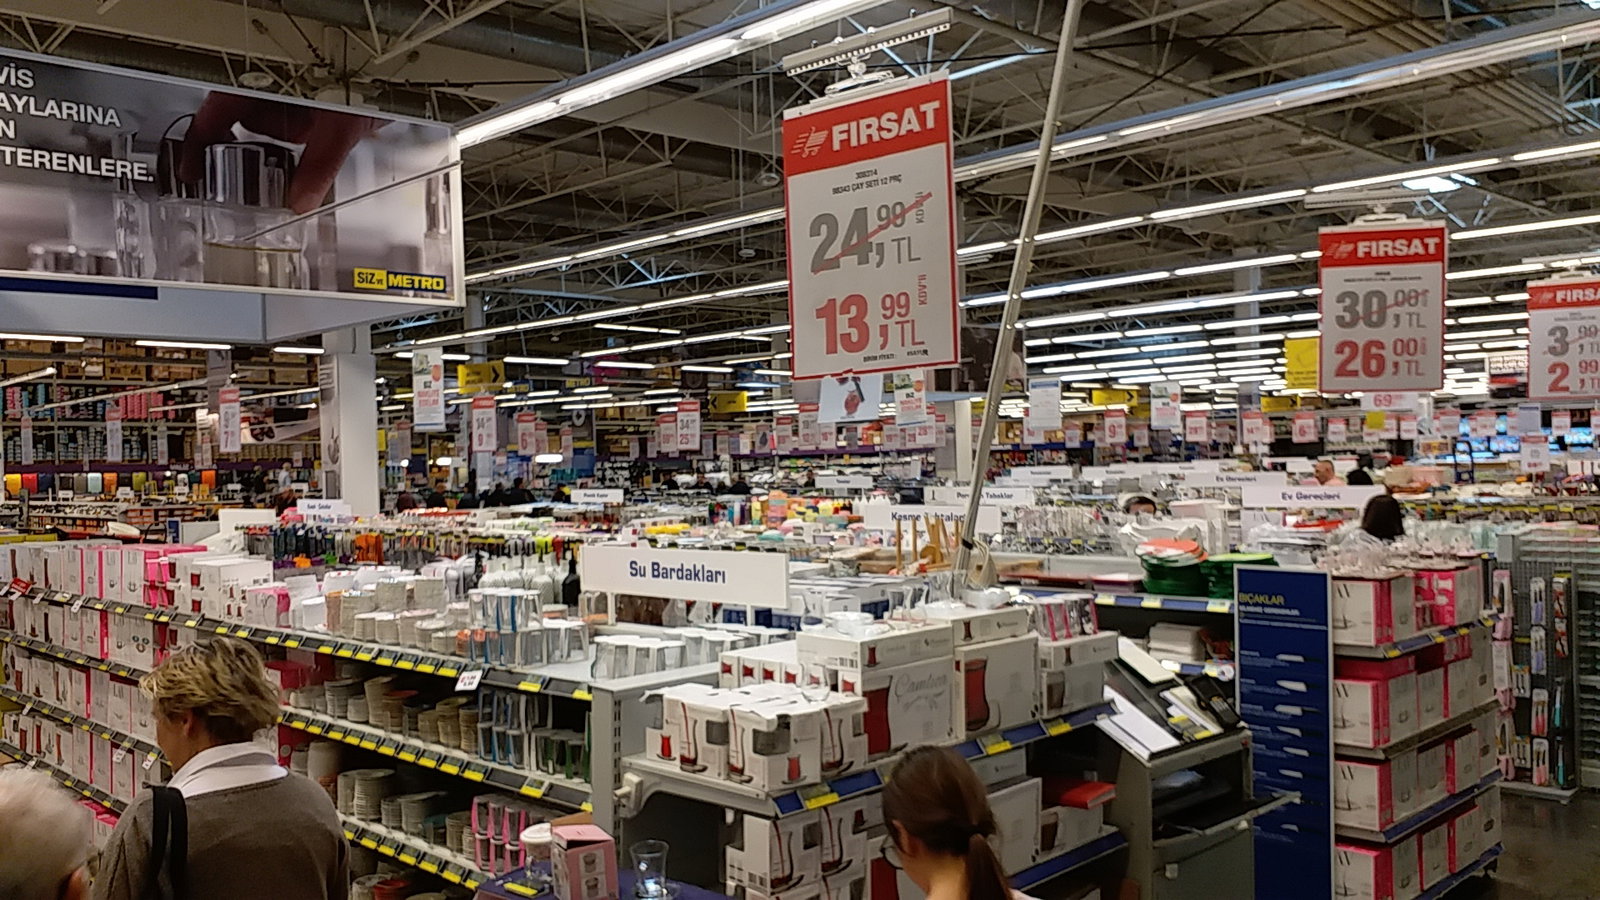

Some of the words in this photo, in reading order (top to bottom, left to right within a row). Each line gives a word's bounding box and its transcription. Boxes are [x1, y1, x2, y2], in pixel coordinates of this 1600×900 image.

[831, 100, 941, 152] FIRSAT
[1356, 236, 1440, 259] FIRSAT
[388, 273, 445, 291] METRO
[1281, 492, 1293, 500] Ev
[891, 511, 921, 522] Kesme
[629, 560, 646, 578] Su
[651, 561, 726, 584] Bardakları
